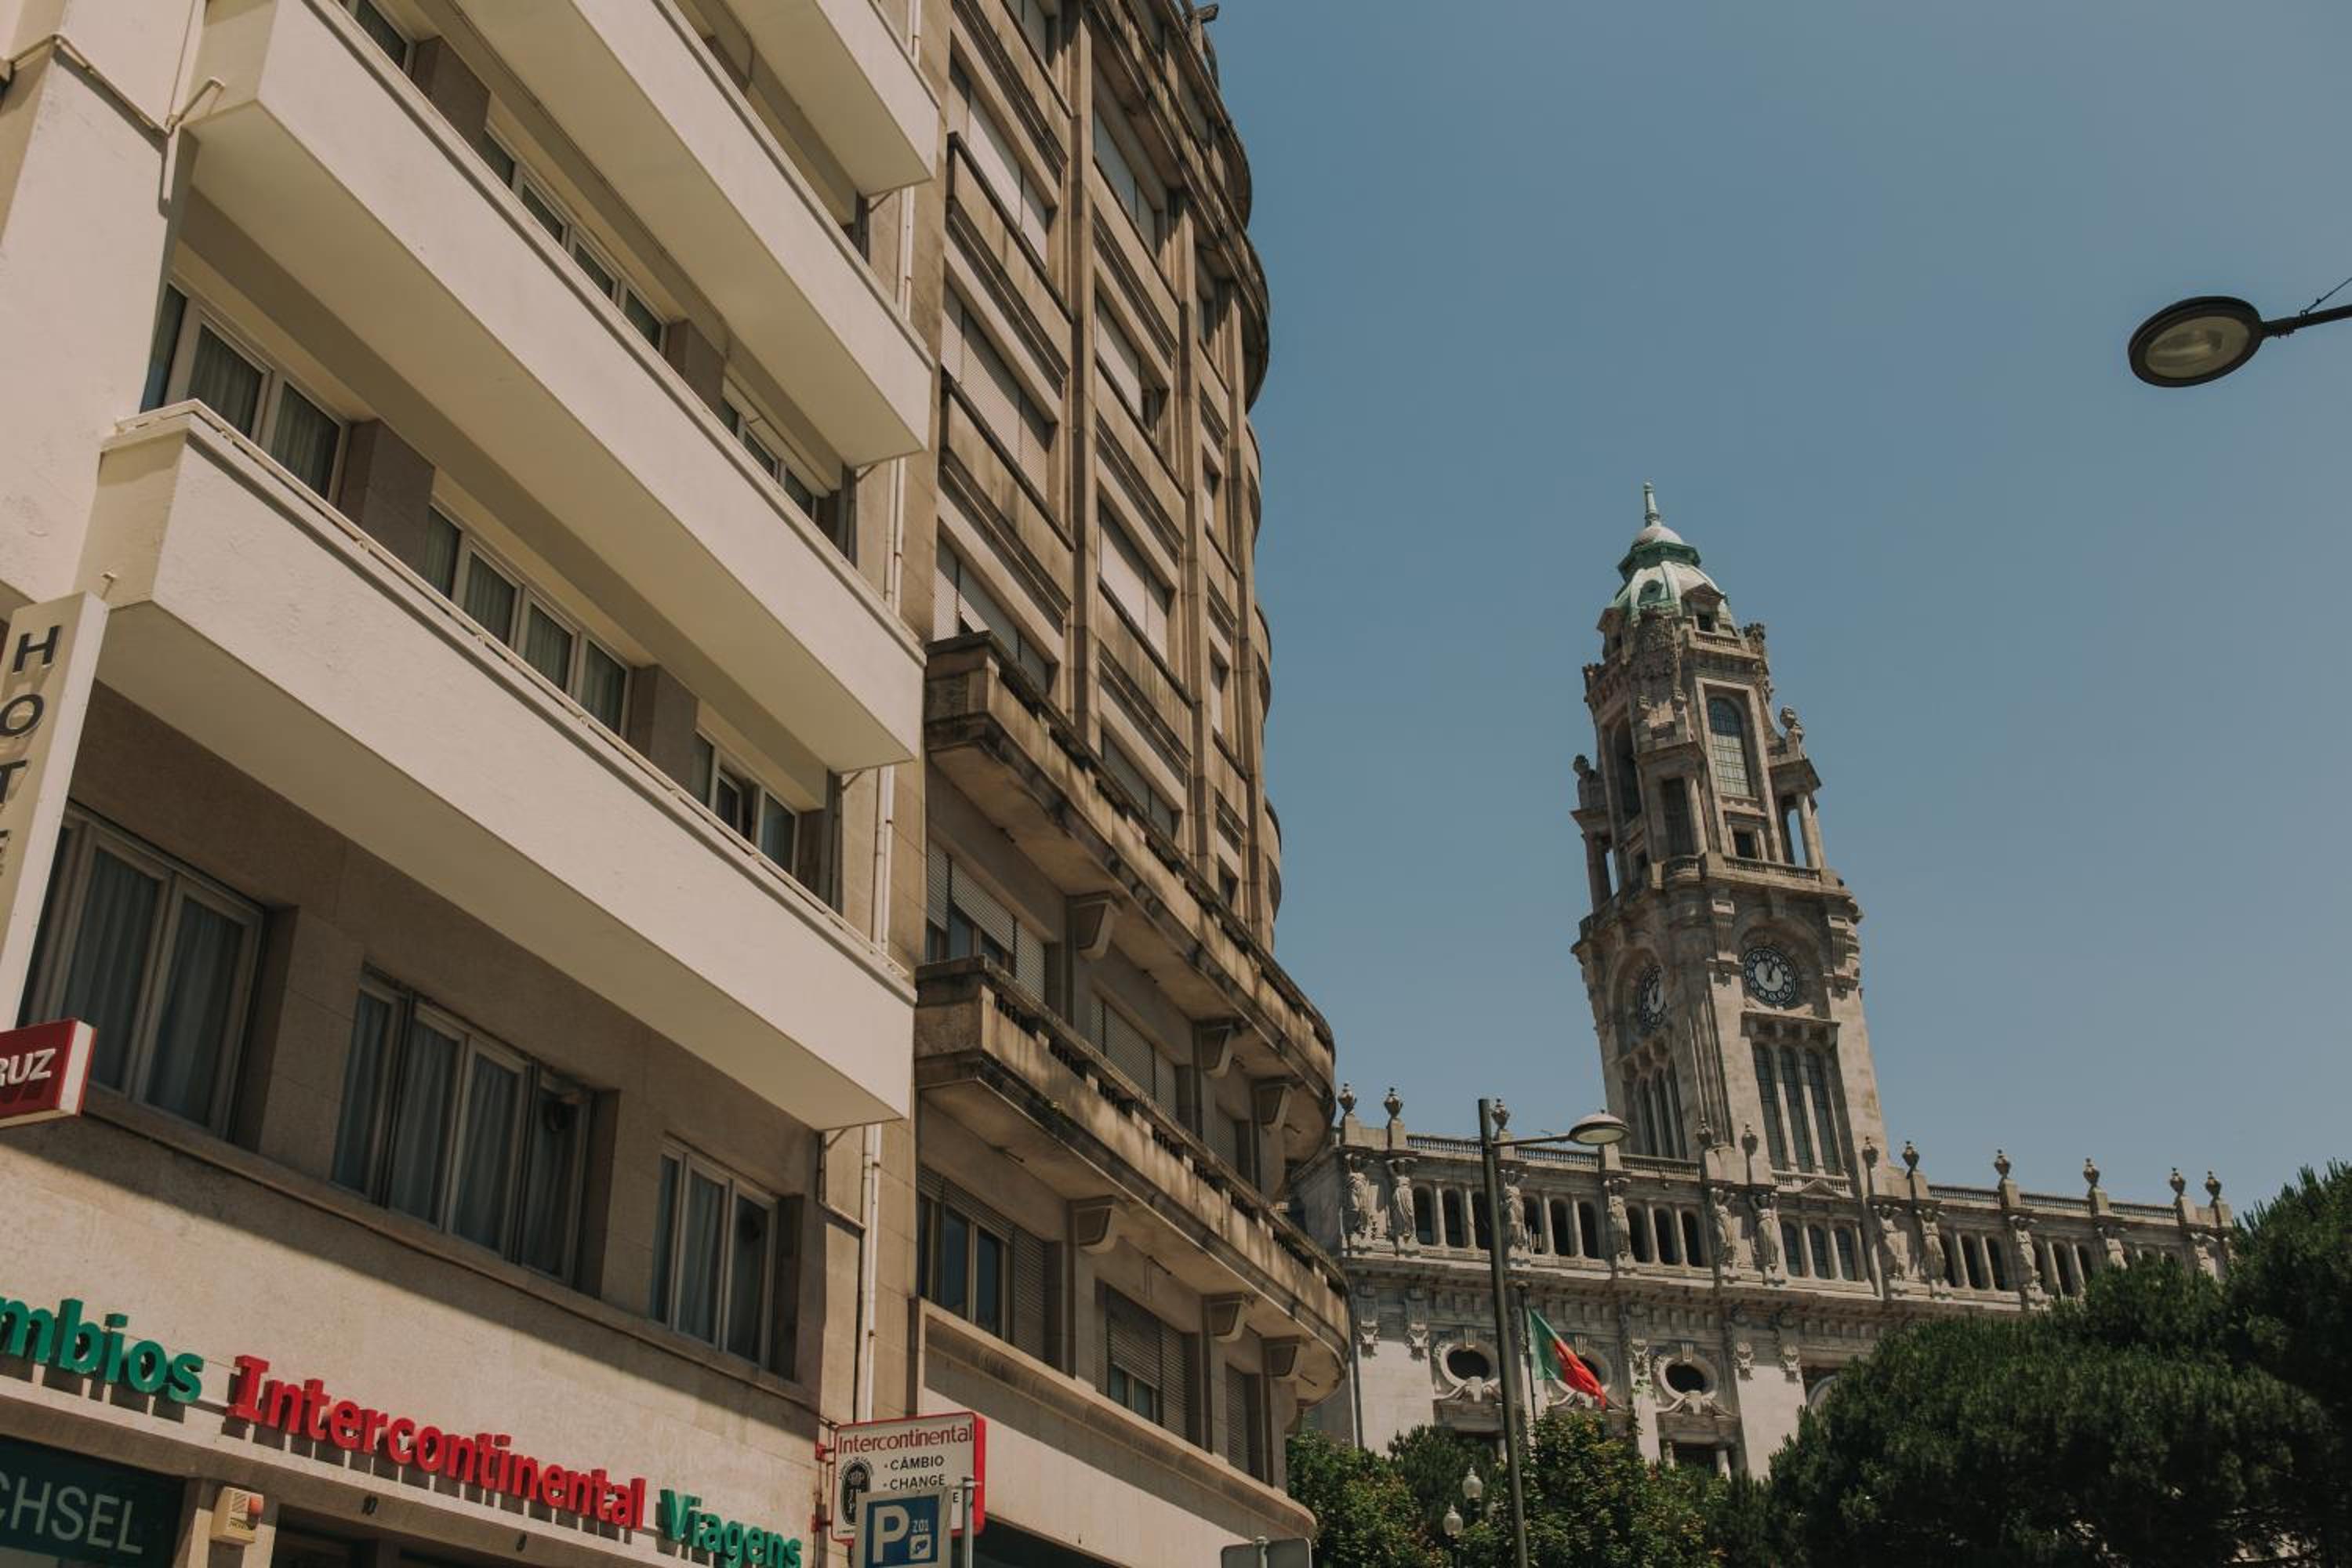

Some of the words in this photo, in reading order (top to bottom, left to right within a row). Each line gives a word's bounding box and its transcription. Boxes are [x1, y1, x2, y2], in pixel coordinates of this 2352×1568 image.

[226, 1354, 646, 1530] Intercontinental
[659, 1488, 803, 1568] Viagens
[838, 1424, 973, 1454] Intercontinental
[890, 1474, 946, 1490] CHANGE
[873, 1505, 909, 1563] P
